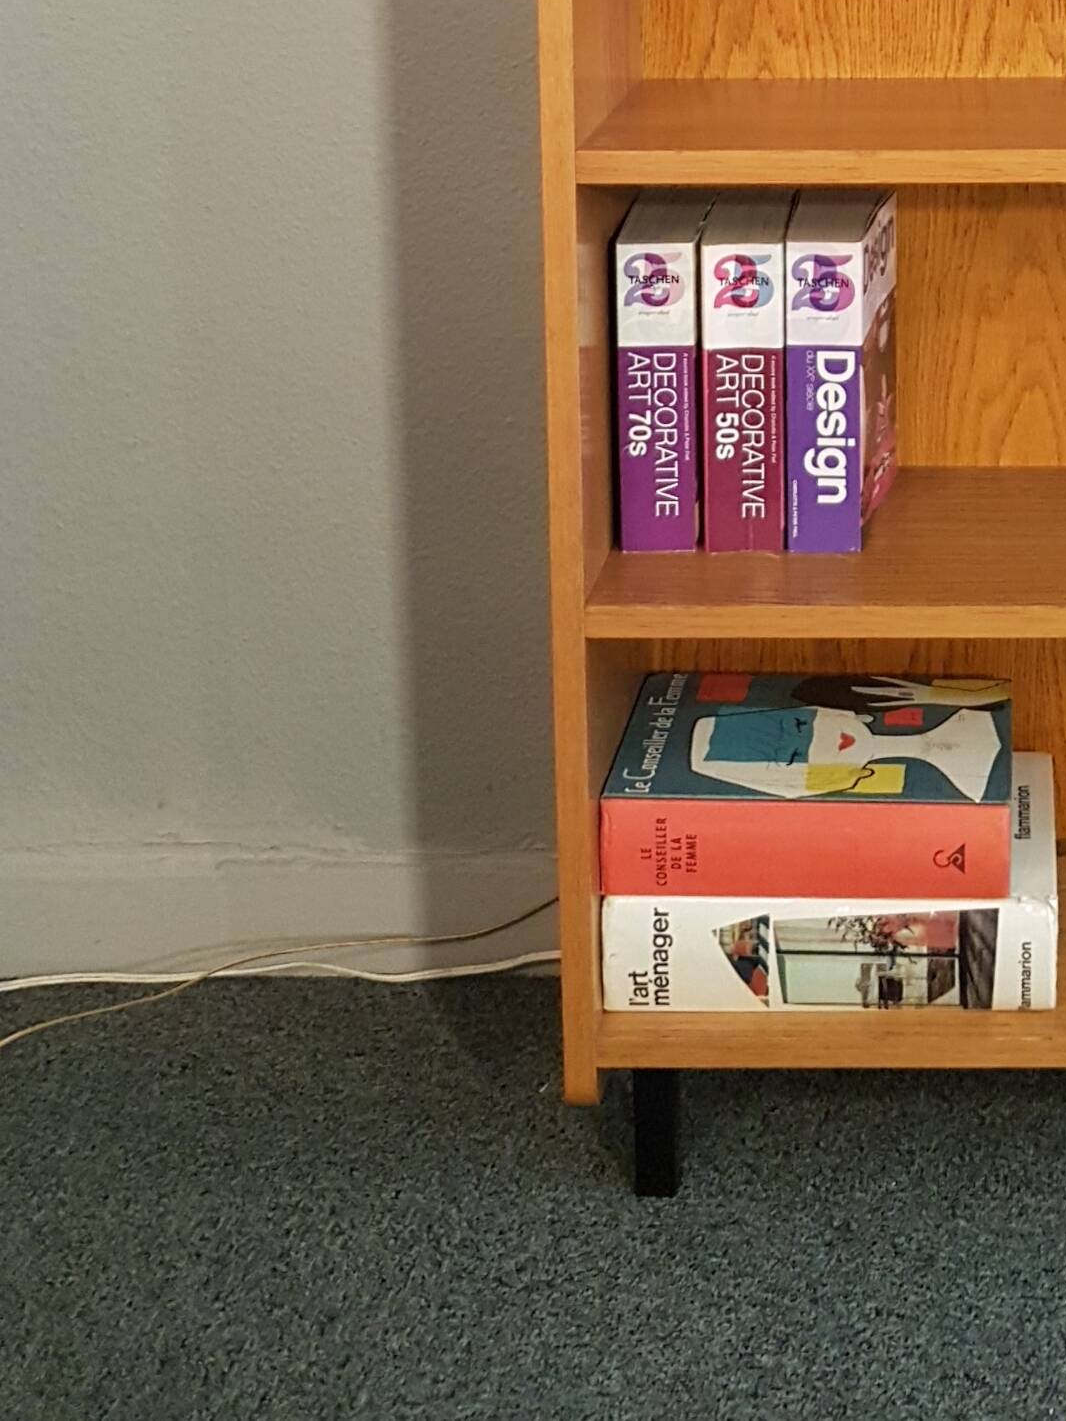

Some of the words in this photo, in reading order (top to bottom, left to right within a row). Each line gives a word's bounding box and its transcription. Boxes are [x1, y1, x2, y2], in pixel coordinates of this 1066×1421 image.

[628, 275, 680, 285] TASCHEN
[719, 277, 769, 287] TASCHEN
[797, 277, 850, 288] TASCHEN
[806, 349, 815, 363] du
[628, 352, 651, 405] ART
[716, 354, 739, 407] ART
[628, 410, 652, 457] 70s
[653, 353, 679, 517] DECORATIVE
[716, 413, 739, 459] 50s
[741, 355, 765, 518] DECORATIVE
[804, 351, 856, 504] Design
[648, 673, 688, 706] Femme
[649, 717, 674, 729] de
[653, 707, 676, 716] la
[622, 730, 669, 781] Conseiller
[624, 781, 651, 793] Le
[1014, 785, 1030, 840] flammarion
[640, 847, 652, 859] LE
[656, 817, 668, 886] CONSEILLER
[671, 837, 682, 852] LA
[671, 856, 682, 870] DE
[686, 834, 697, 873] FEMME
[648, 907, 673, 1005] ménager
[628, 971, 650, 1006] l'art
